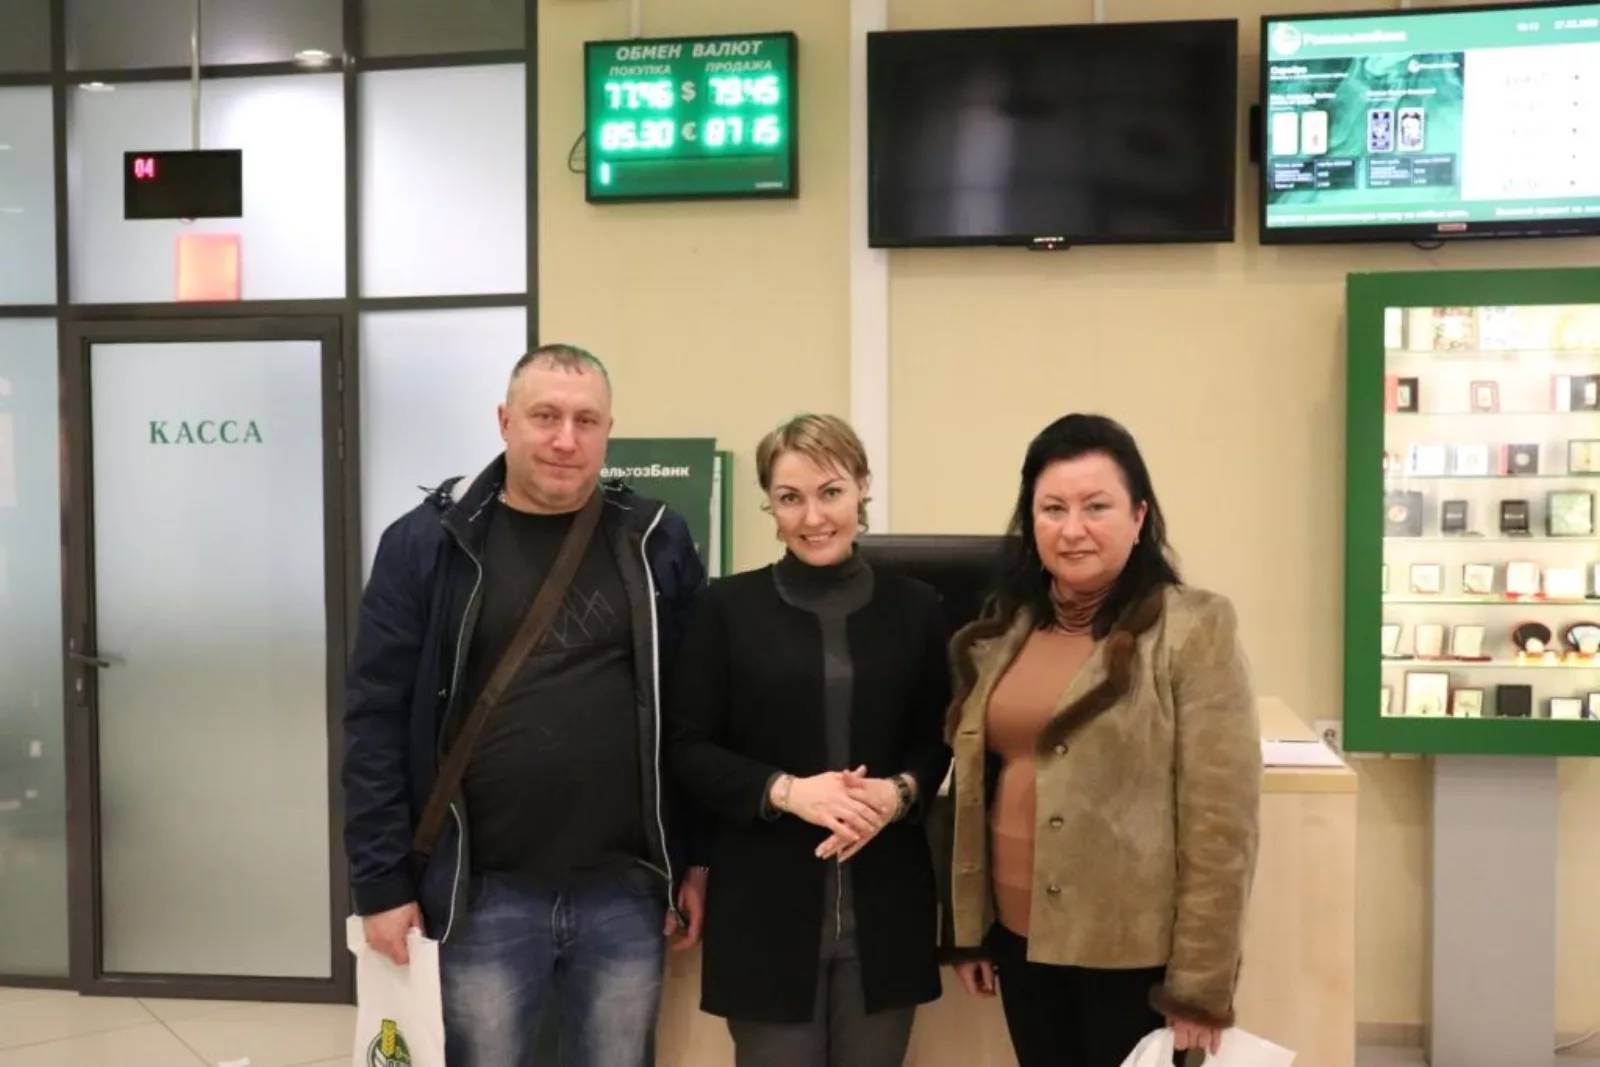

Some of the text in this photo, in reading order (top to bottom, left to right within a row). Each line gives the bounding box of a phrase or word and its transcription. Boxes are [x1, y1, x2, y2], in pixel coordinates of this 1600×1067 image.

[615, 40, 763, 61] ОБМЕН ВАЛЮТ
[609, 65, 672, 77] ПОКУПКА
[704, 60, 773, 72] ПРОДАЖА
[135, 158, 154, 178] 04
[149, 420, 263, 444] КАССА
